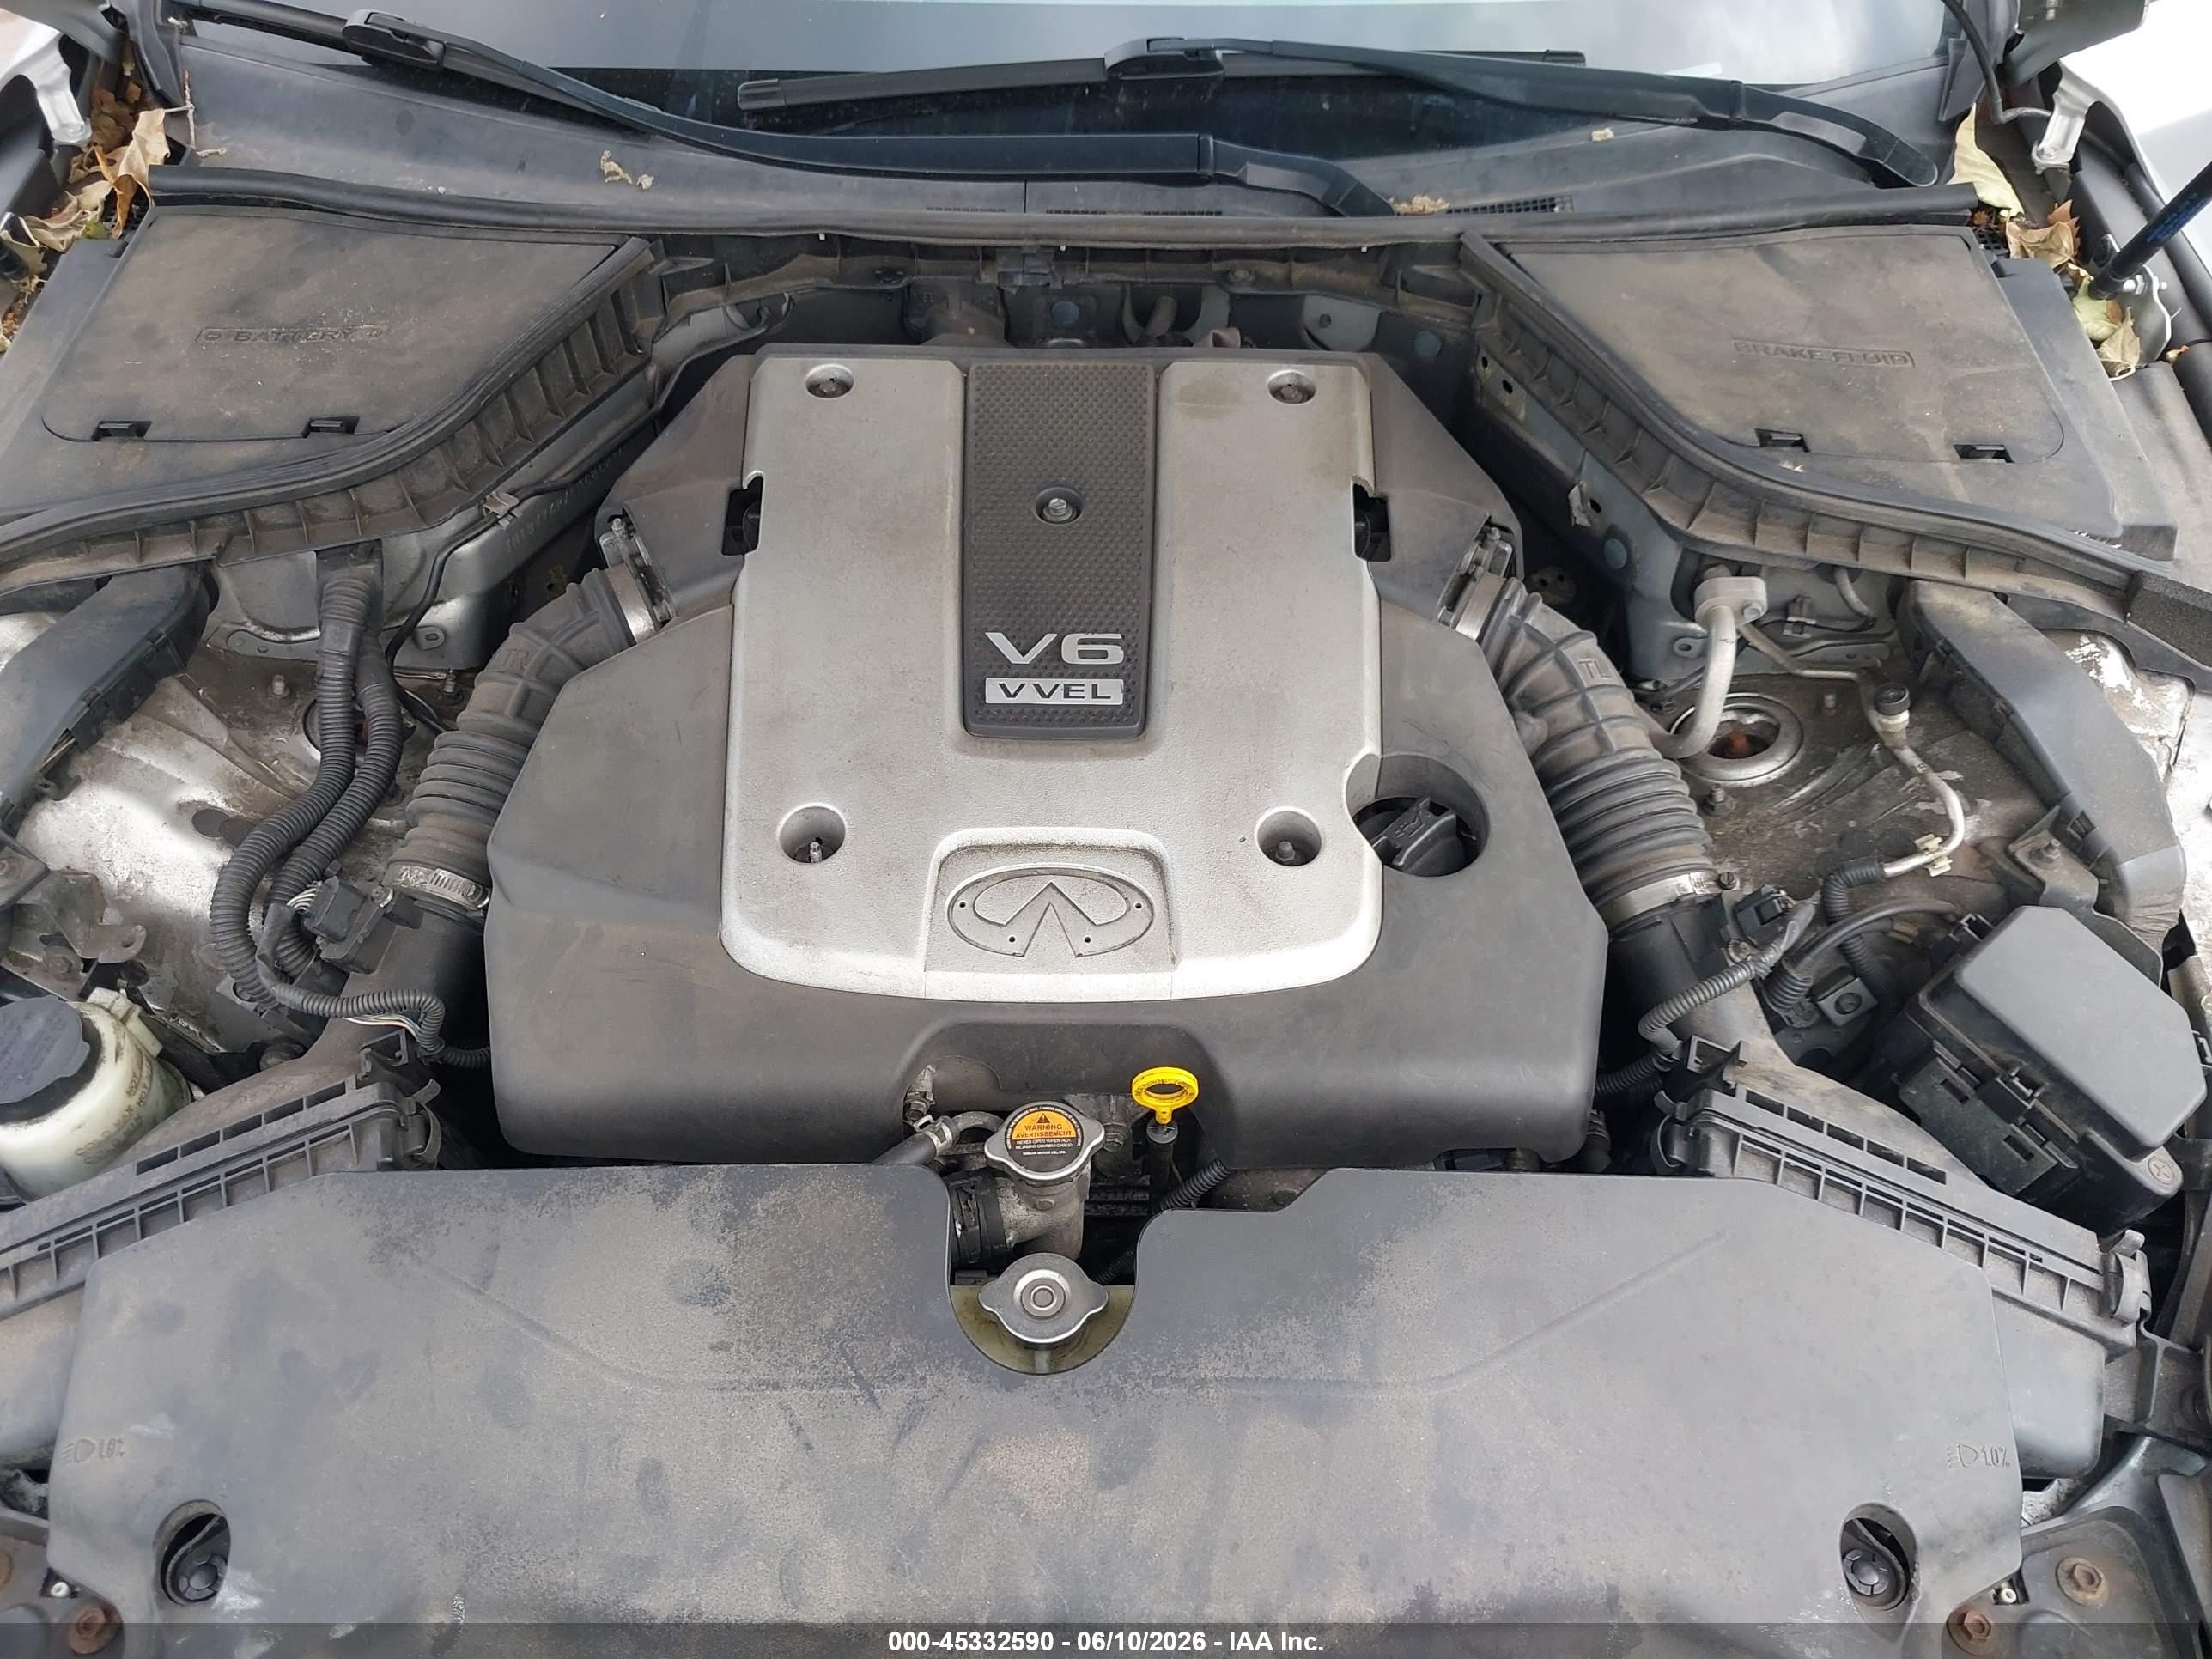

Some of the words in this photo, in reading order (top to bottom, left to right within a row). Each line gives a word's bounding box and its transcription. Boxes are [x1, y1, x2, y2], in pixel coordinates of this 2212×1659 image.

[233, 328, 355, 343] BATTERY
[1733, 342, 1824, 361] BRAKE
[1832, 350, 1910, 366] FLUID
[985, 631, 1124, 665] V6
[998, 683, 1112, 700] VVEL
[1016, 1130, 1073, 1139] AVERTISSEMENT
